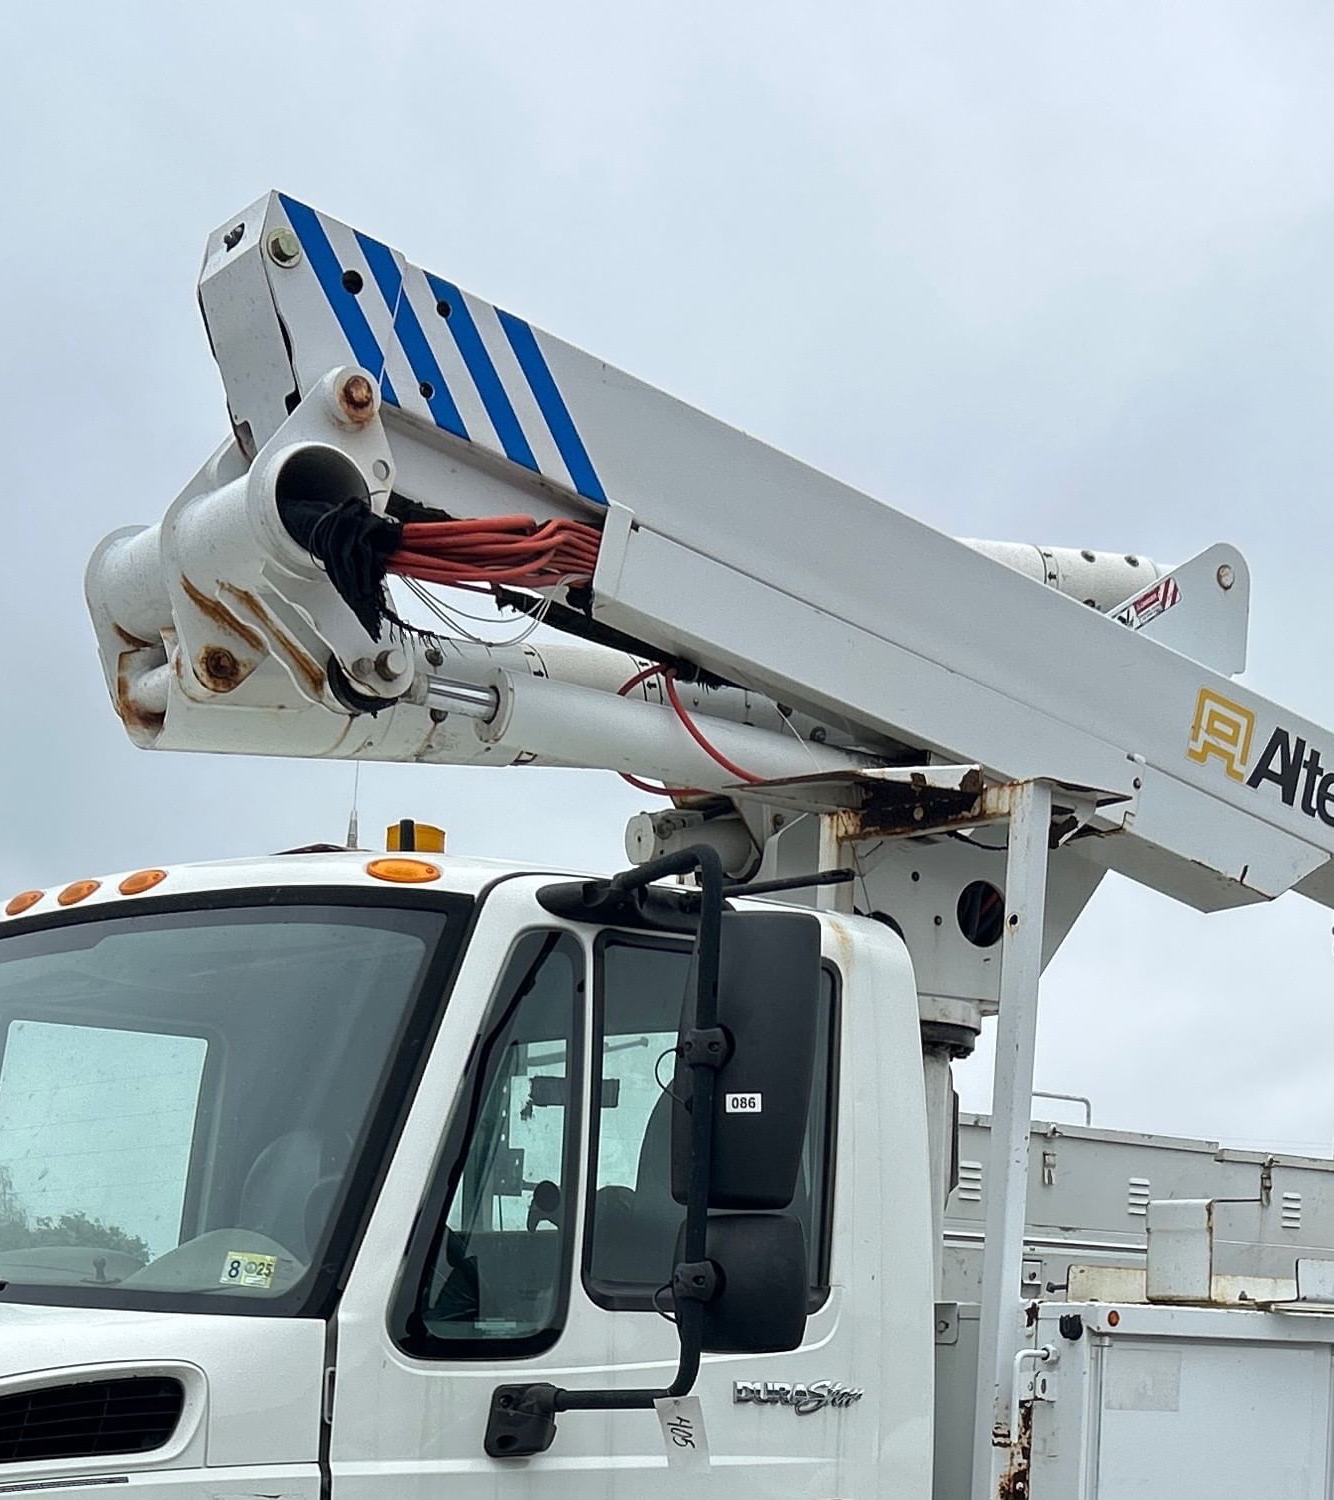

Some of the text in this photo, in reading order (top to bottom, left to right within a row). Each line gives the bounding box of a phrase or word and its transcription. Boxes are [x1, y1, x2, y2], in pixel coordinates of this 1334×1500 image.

[731, 1096, 756, 1109] 086
[228, 1260, 273, 1278] 8 25
[667, 1416, 695, 1448] 405
